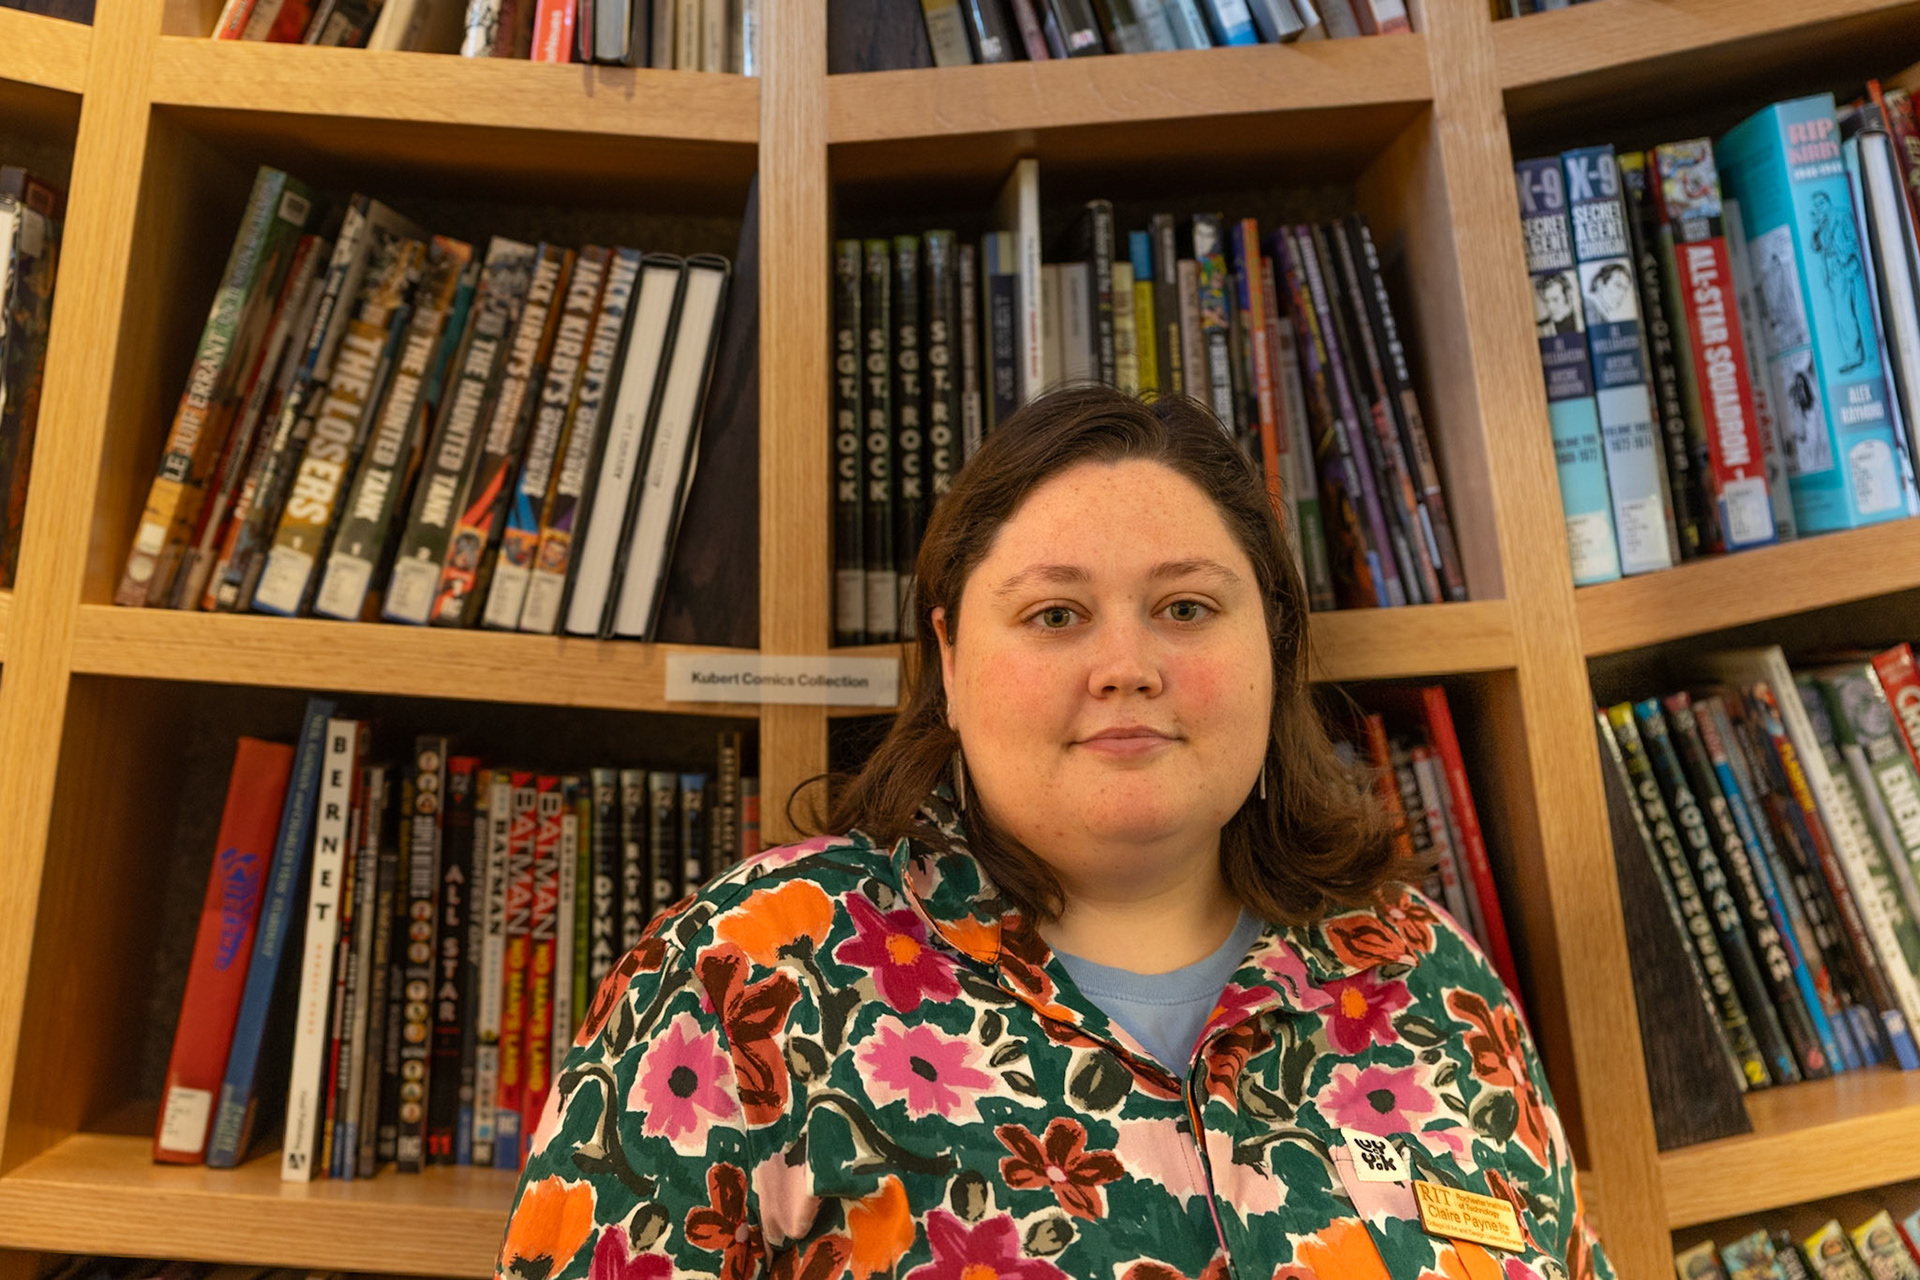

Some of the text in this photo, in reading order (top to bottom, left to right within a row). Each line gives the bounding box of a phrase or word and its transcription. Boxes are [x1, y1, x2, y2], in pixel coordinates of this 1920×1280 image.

[1788, 119, 1833, 145] RIP
[1789, 142, 1840, 165] KIRBY
[1566, 153, 1619, 202] X-9
[1572, 201, 1622, 225] SECRET
[1576, 221, 1625, 243] AGENT
[531, 260, 559, 304] JACK
[1686, 245, 1729, 346] ALL-STAR
[399, 330, 434, 375] THE
[464, 335, 499, 379] THE
[507, 305, 549, 380] KIRBY'S
[542, 257, 604, 405] JACK KIRBY'S
[577, 255, 640, 405] JACK KIRBY'S
[184, 328, 232, 409] ERRANT
[329, 331, 380, 399] THE
[1641, 252, 1690, 472] ACTION HEROES
[371, 373, 420, 467] HAUNTED
[837, 329, 858, 502] SGT. ROCK
[867, 329, 889, 502] SGT. ROCK
[899, 325, 922, 499] SGT. ROCK
[929, 320, 952, 494] SGT. ROCK
[1704, 346, 1752, 469] SQUADRON
[1840, 401, 1885, 425] RAYMOND
[1847, 384, 1872, 404] ALEX
[169, 406, 206, 458] JUIF
[437, 378, 486, 472] HAUNTED
[160, 452, 190, 484] LE
[284, 392, 361, 526] LOSERS
[353, 465, 392, 523] TANK
[419, 469, 458, 529] TANK
[691, 671, 869, 689] Kubert Comics Collection
[312, 735, 350, 923] BERNET
[489, 819, 506, 935] BATMAN
[508, 787, 536, 936] BATMAN
[532, 791, 562, 941] BATMAN
[1675, 786, 1741, 932] AQUAMAN
[440, 864, 465, 1022] ALL STAR
[509, 937, 526, 969] NO
[534, 942, 551, 974] NO
[1639, 779, 1732, 996] CHALLENGERS
[1745, 1060, 1765, 1083] 2
[1758, 926, 1792, 983] MAN
[502, 1035, 522, 1087] LAND
[528, 1039, 547, 1092] LAND
[429, 1134, 452, 1156] 11
[1419, 1183, 1451, 1207] RIT
[1428, 1205, 1499, 1232] Claire Payne
[1455, 1193, 1512, 1213] Rochester Institute
[1466, 1204, 1500, 1219] Technology
